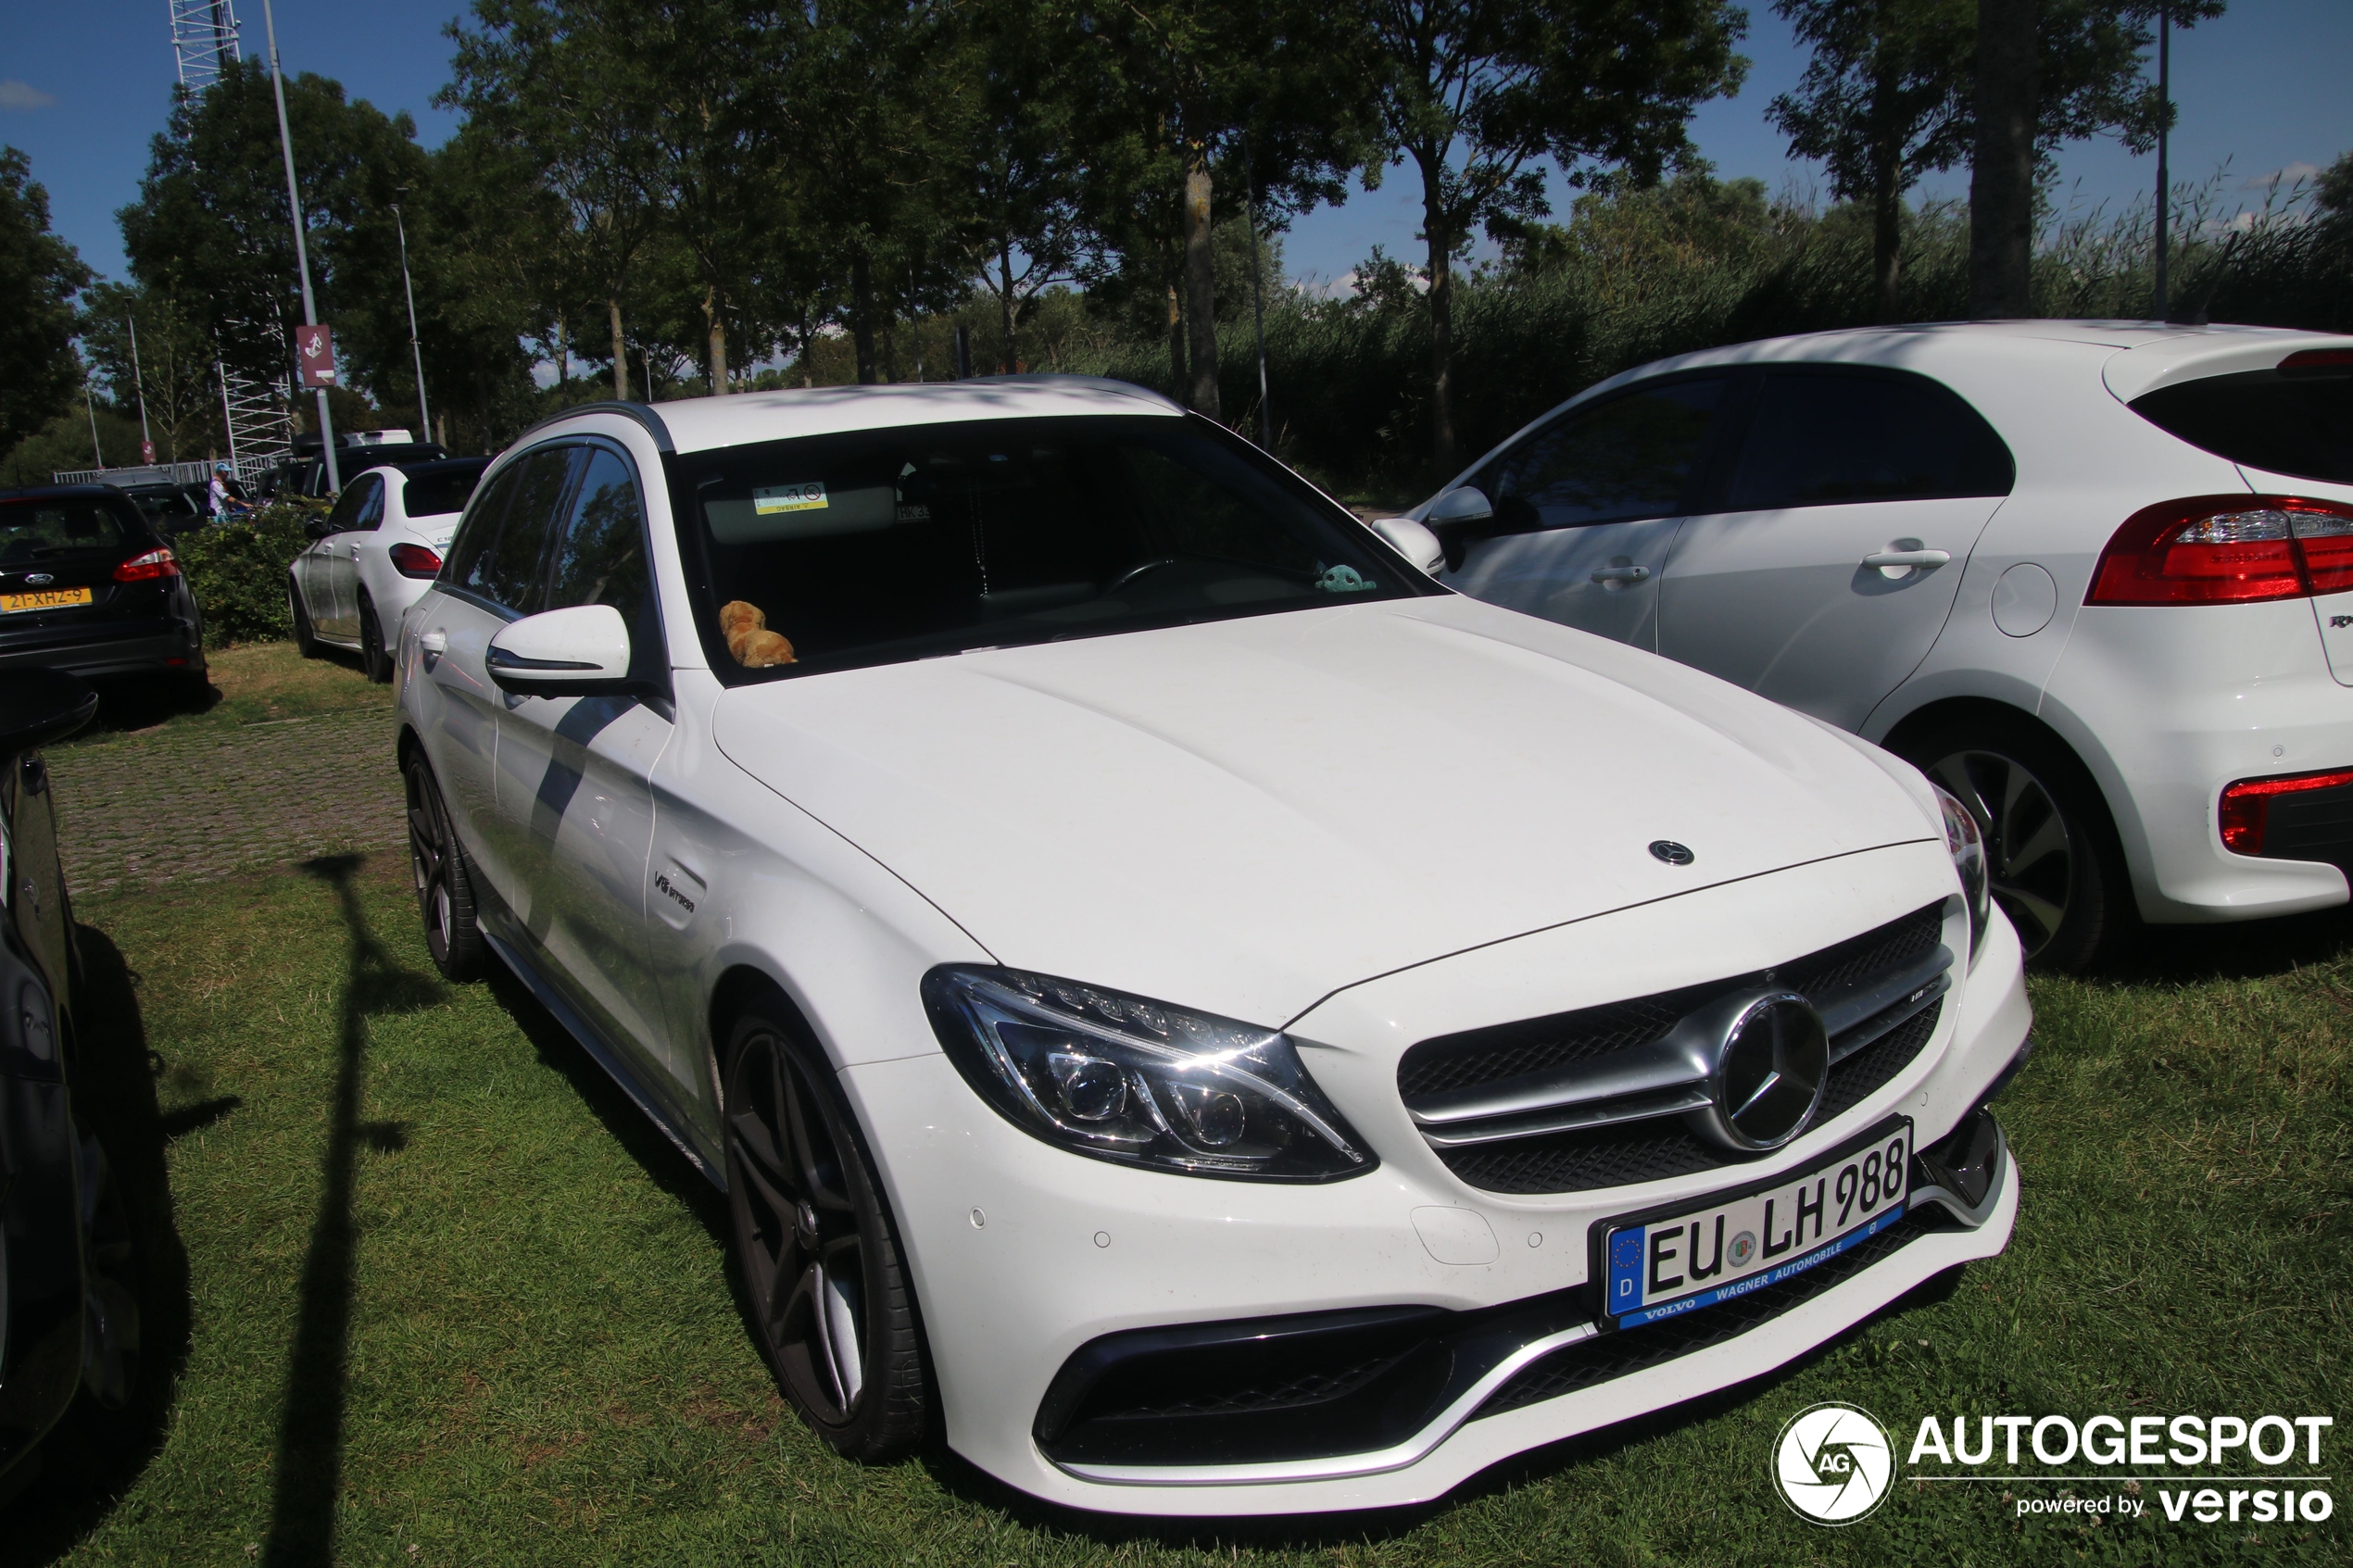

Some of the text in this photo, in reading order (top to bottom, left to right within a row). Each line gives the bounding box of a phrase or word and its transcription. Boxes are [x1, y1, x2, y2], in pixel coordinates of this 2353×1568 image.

[776, 504, 800, 512] AIRBAG
[9, 589, 82, 608] 21-XHZ-9
[1648, 1214, 1724, 1295] EU
[1763, 1177, 1826, 1260] LH
[1836, 1138, 1904, 1227] 988
[1619, 1278, 1632, 1297] D
[1644, 1299, 1696, 1320] VOLVO
[1717, 1274, 1768, 1300] WAGNER
[1775, 1242, 1842, 1280] AUTOMOBILE
